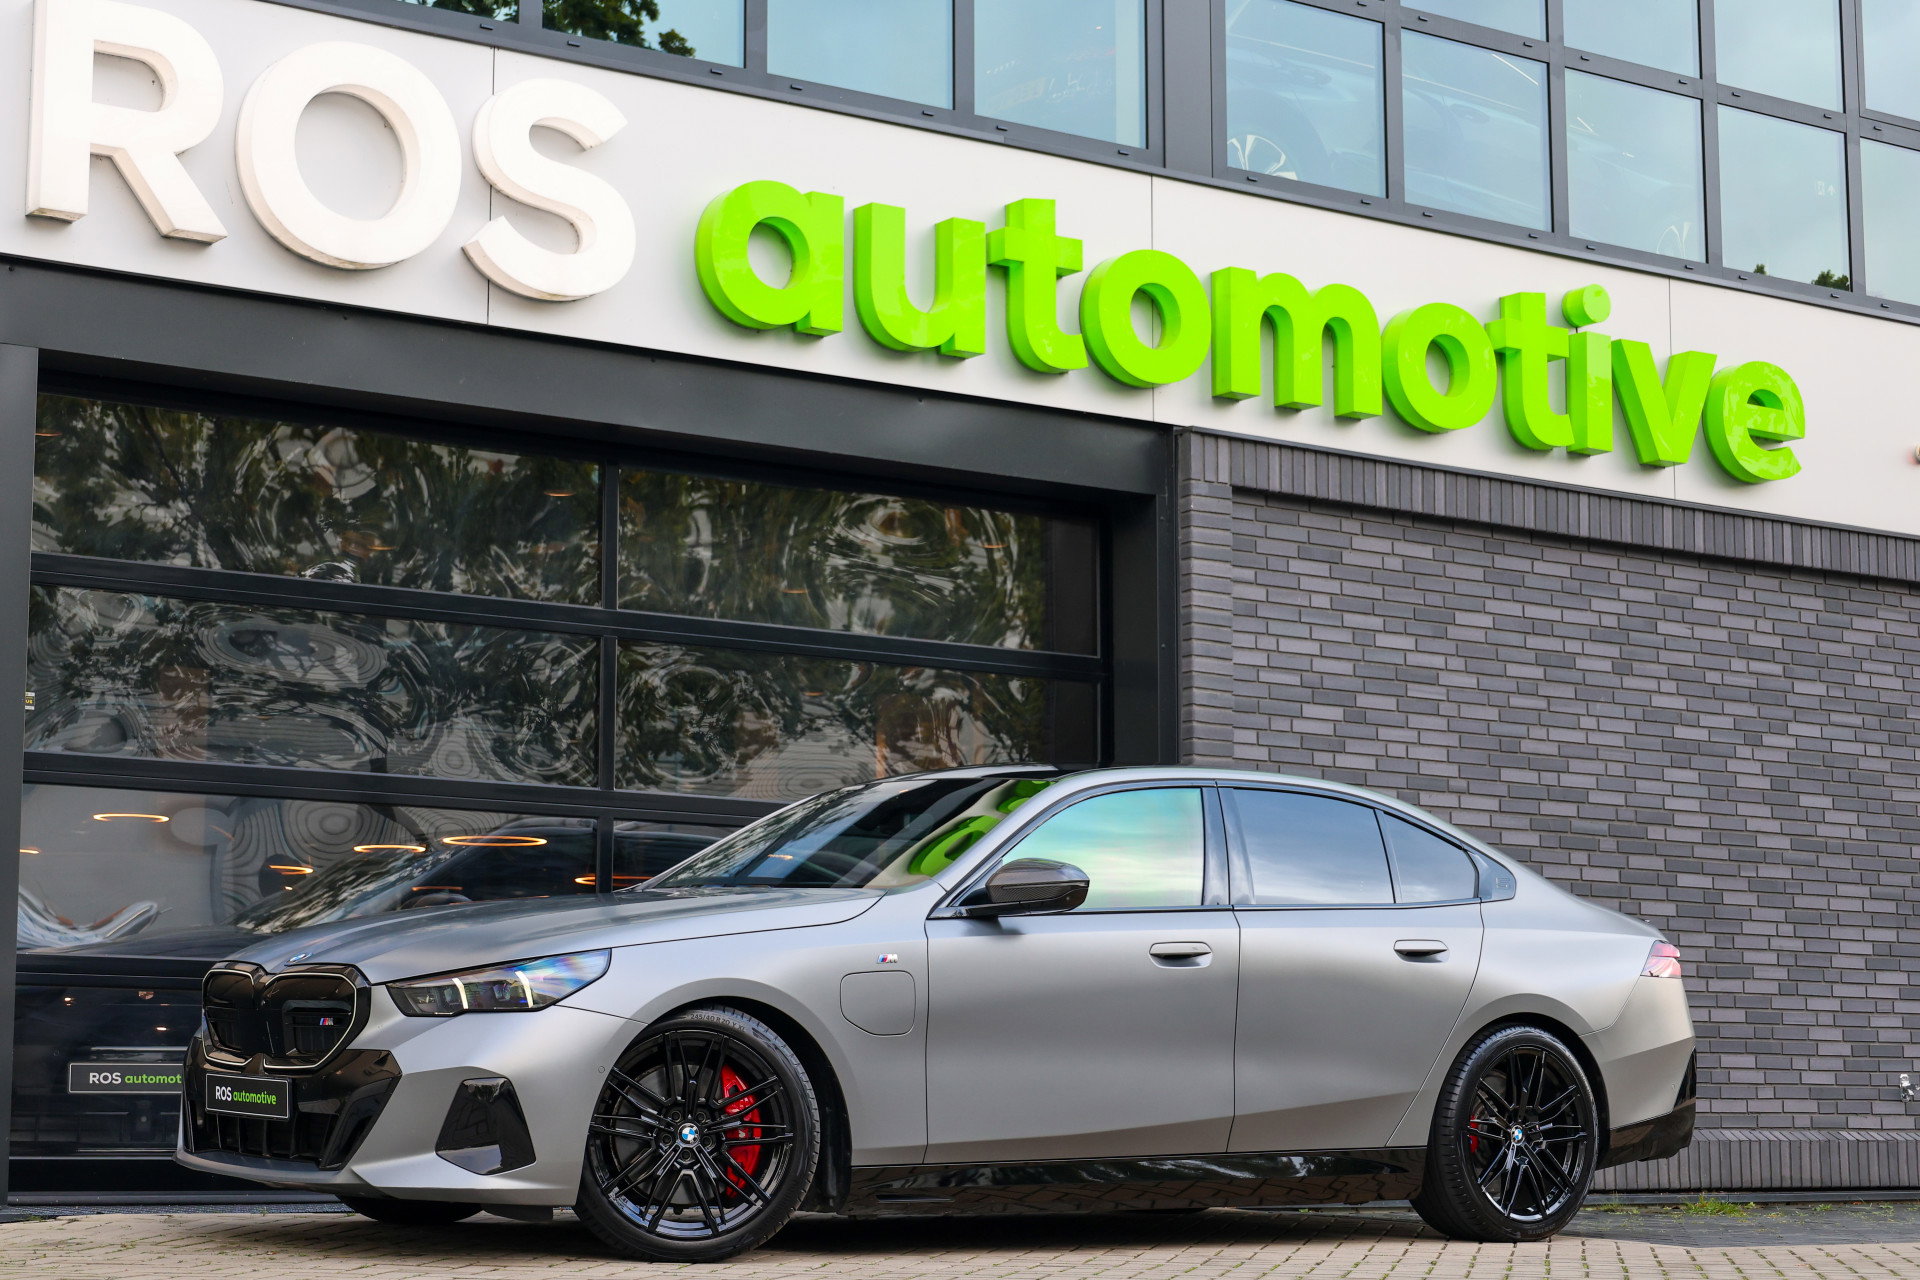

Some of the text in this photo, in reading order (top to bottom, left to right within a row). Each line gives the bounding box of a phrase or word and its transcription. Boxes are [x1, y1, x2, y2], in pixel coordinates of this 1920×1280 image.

[26, 0, 1806, 486] ROS automotive
[89, 1072, 183, 1084] ROS automot
[215, 1085, 277, 1105] ROS automotive
